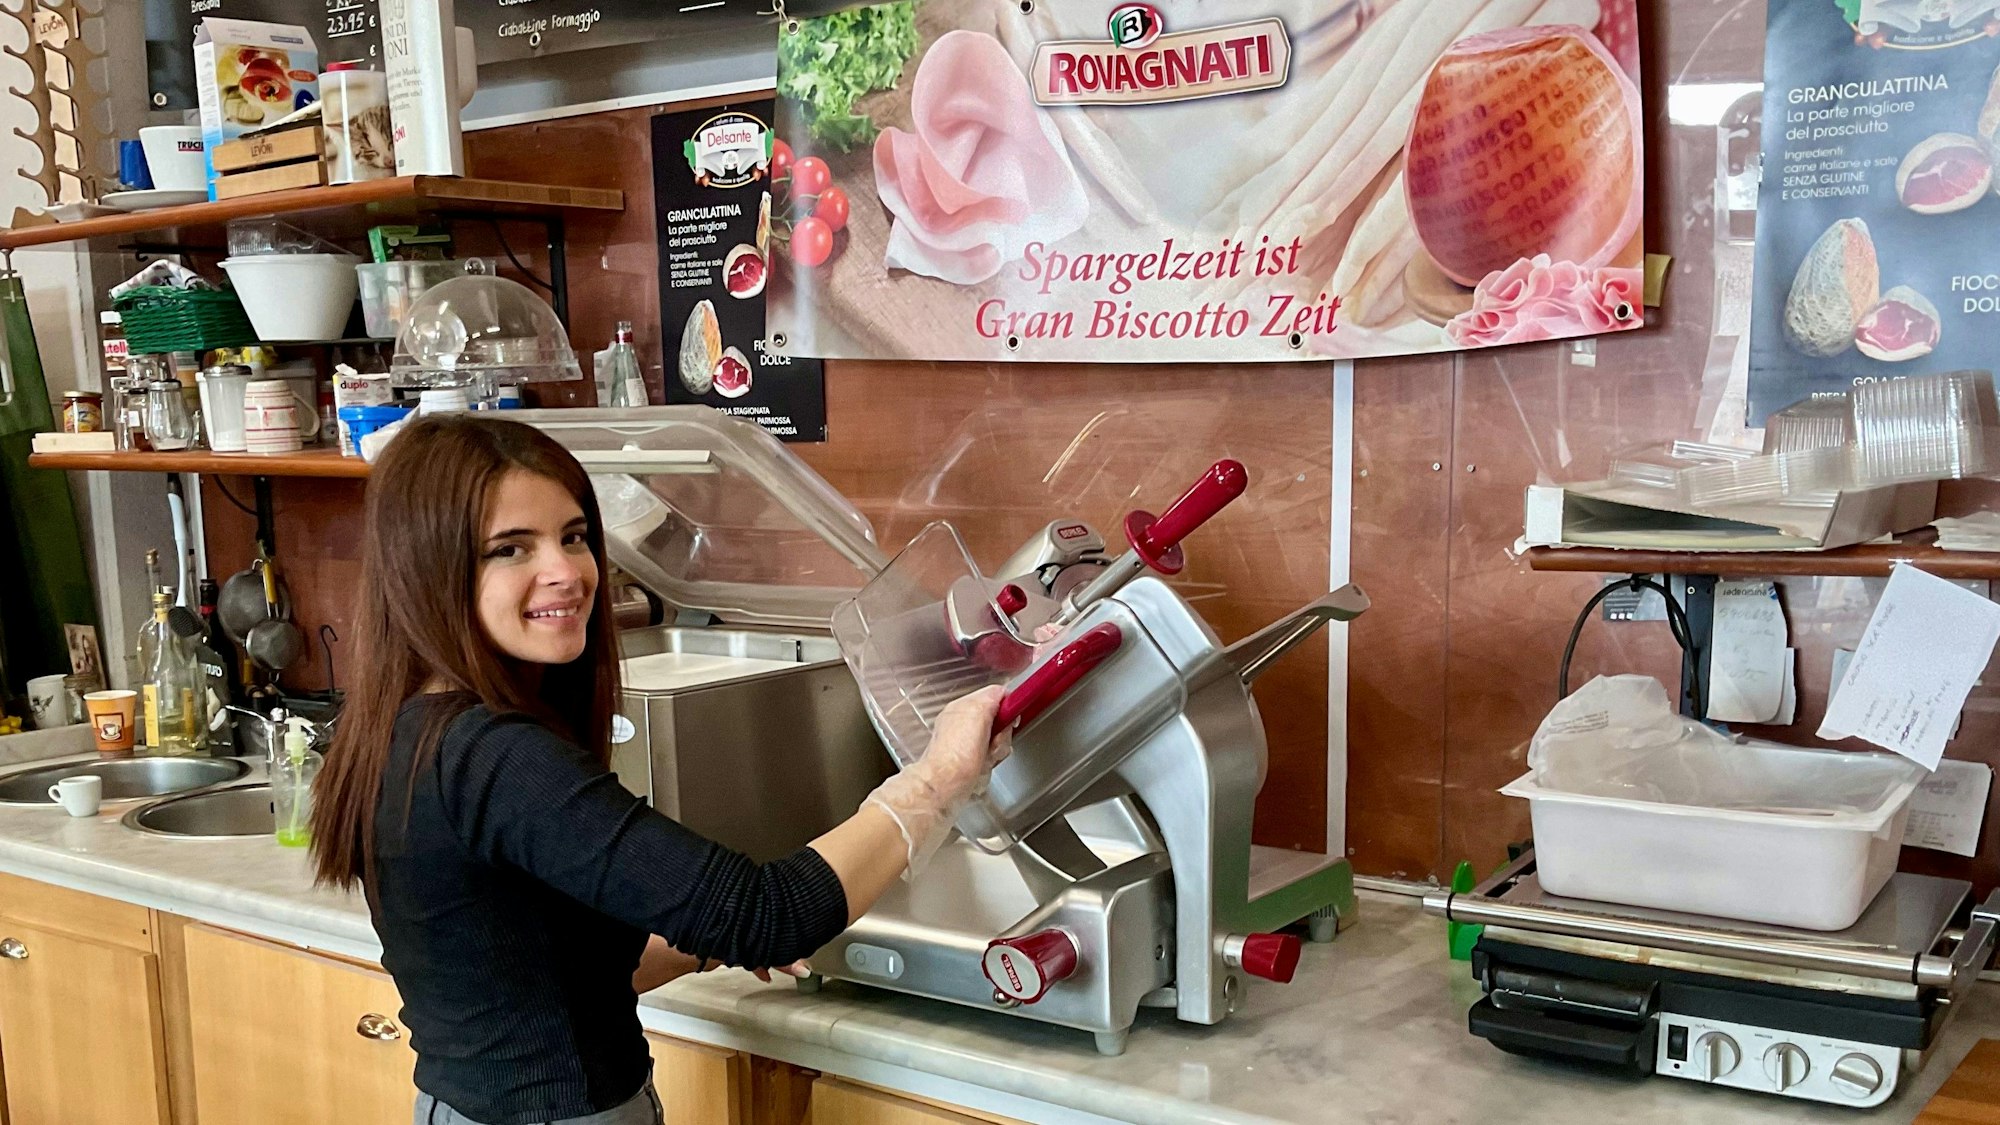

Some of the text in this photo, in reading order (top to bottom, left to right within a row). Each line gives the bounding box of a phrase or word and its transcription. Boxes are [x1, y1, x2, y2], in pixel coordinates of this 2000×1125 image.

[498, 9, 600, 37] Ciabattine Formaggio
[1047, 34, 1272, 95] ROVAGNATI
[1788, 73, 1949, 104] GRANCULATTINA
[1787, 101, 1915, 123] La parte migliore
[707, 129, 751, 147] Delsante
[1785, 121, 1889, 141] del prosciutto
[251, 143, 273, 157] LEVONI
[1784, 146, 1844, 162] Ingredienti
[1783, 156, 1898, 174] carne italiane e sale
[1783, 171, 1865, 187] SENZA GLUTINE
[1782, 185, 1869, 200] E CONSERVANTI
[667, 204, 742, 222] GRANCULATTINA
[668, 221, 728, 235] La parte migliore
[669, 234, 717, 247] del prosciutto
[671, 268, 710, 279] SENZA GLUTINE
[1018, 235, 1303, 295] Spargelzeit ist
[671, 278, 712, 288] E CONSERVANTI
[975, 293, 1342, 339] Gran Biscotto Zeit
[760, 355, 791, 366] DOLCE
[340, 380, 368, 392] duplo
[733, 407, 770, 415] STAGIONATA
[1003, 955, 1021, 990] BERKEL
